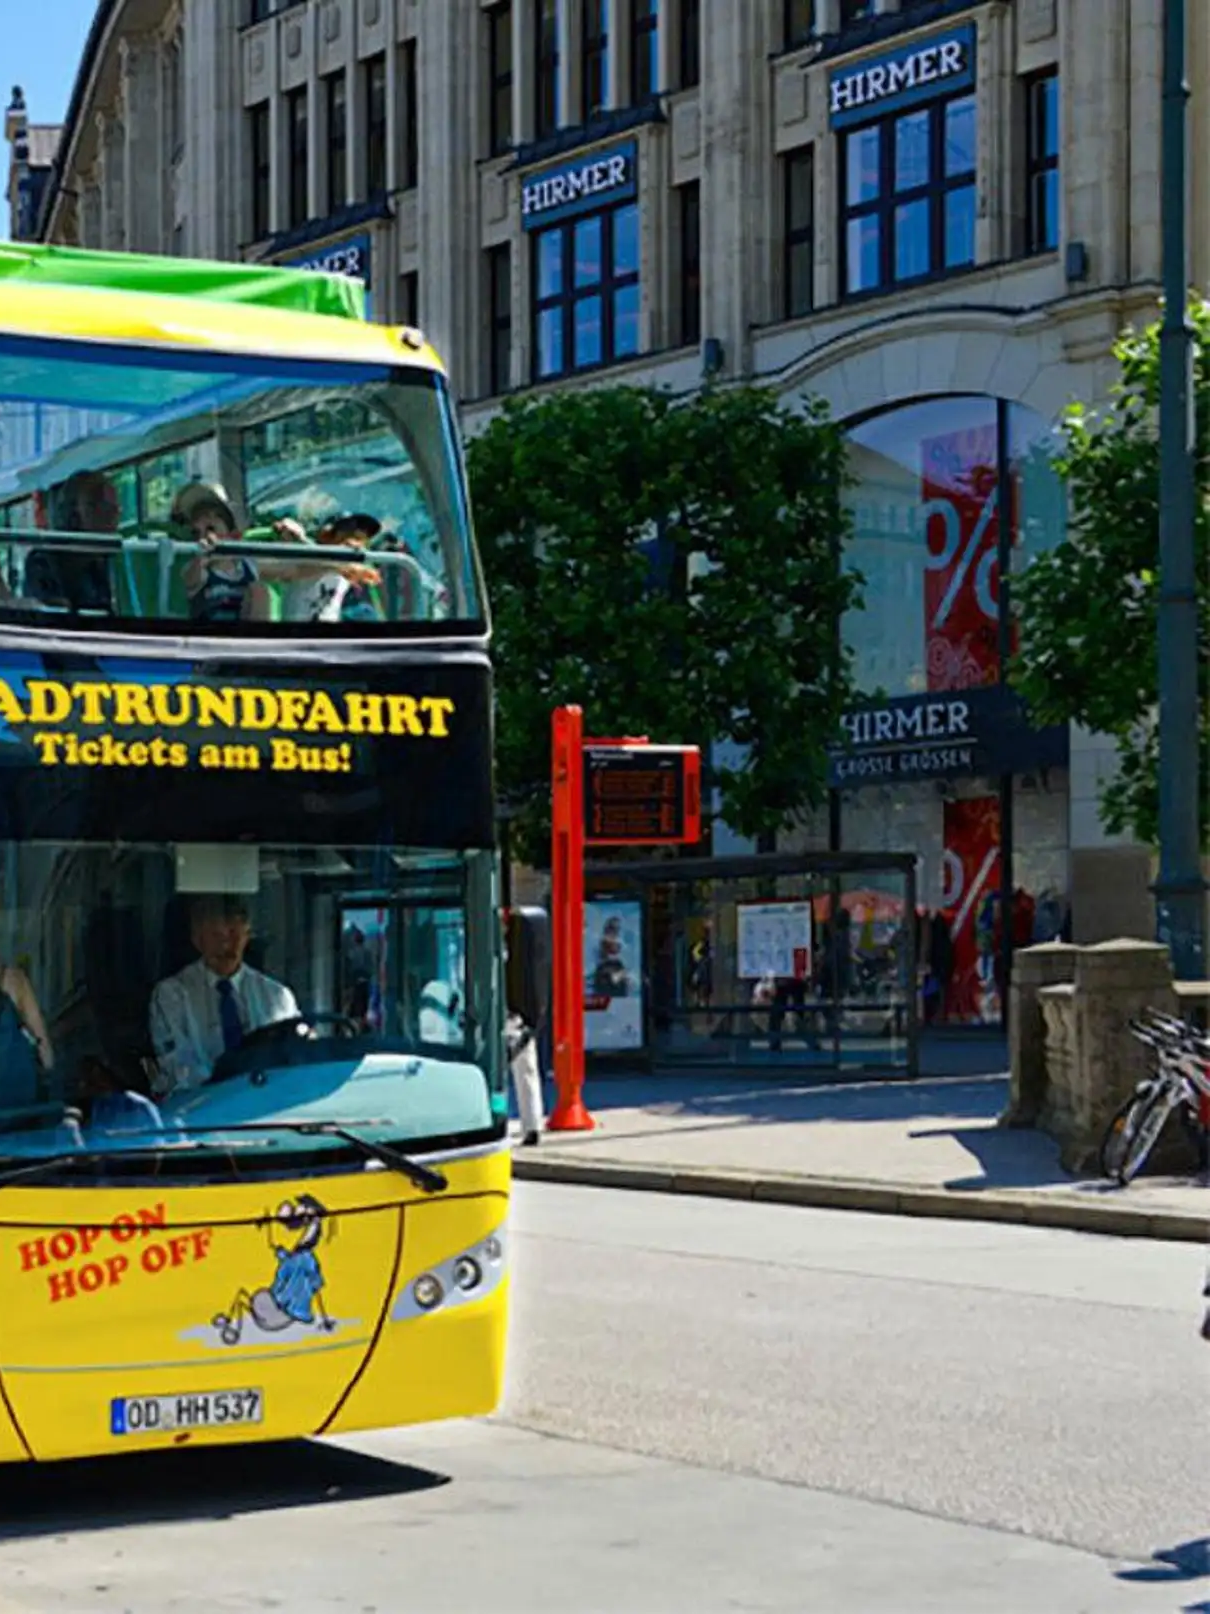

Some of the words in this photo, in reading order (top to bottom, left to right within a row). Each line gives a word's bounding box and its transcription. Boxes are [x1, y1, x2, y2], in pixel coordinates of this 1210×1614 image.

[830, 40, 962, 112] HIRMER
[522, 155, 626, 214] HIRMER
[33, 731, 188, 767] Tickets
[199, 742, 261, 769] am
[269, 737, 352, 772] Bus!
[839, 701, 969, 743] HIRMER
[18, 1225, 103, 1271] HOP
[110, 1202, 167, 1242] ON
[47, 1254, 129, 1303] HOP
[141, 1228, 213, 1273] OFF
[128, 1400, 159, 1428] OD
[176, 1396, 210, 1424] HH
[213, 1390, 260, 1421] 537
